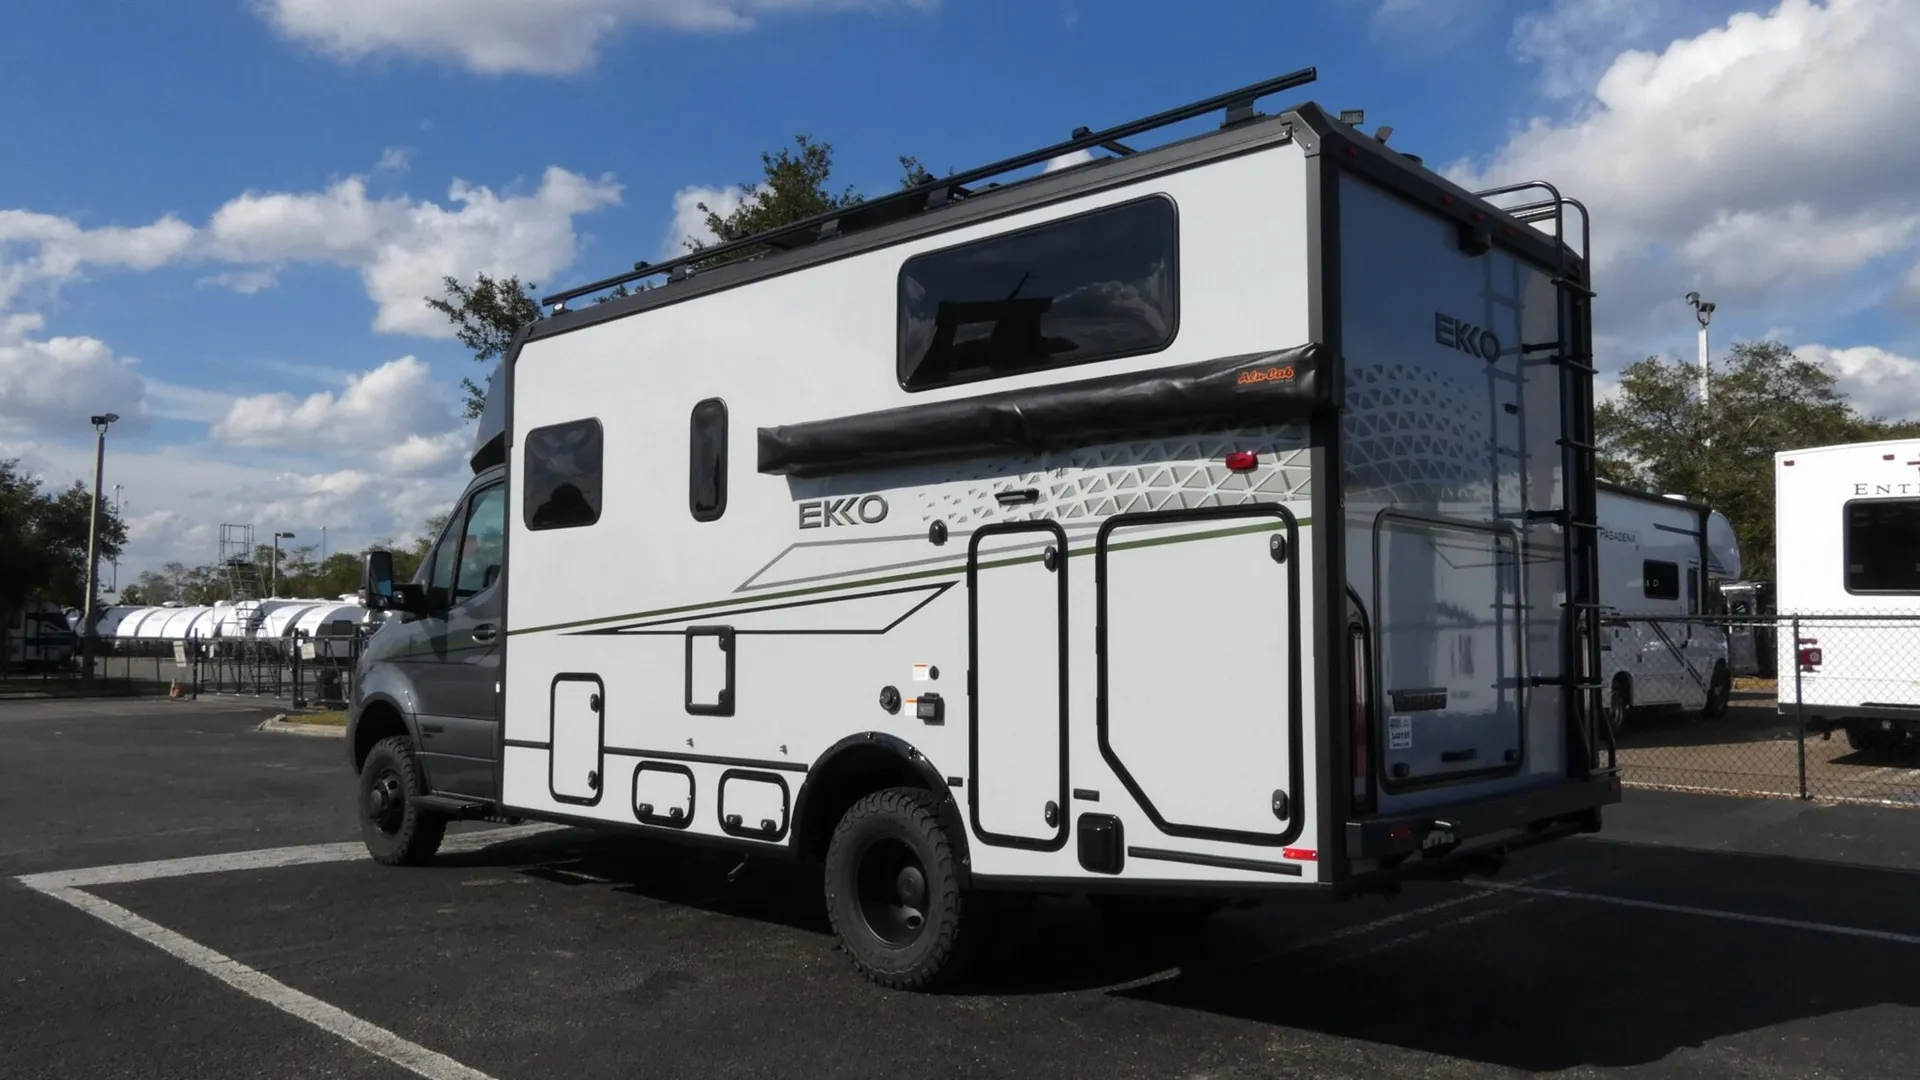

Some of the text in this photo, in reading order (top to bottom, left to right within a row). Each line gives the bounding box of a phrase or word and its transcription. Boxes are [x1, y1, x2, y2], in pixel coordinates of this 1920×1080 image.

[1435, 311, 1501, 363] EKKO
[1238, 365, 1294, 384] Alu-Cab
[1854, 483, 1920, 496] ENT
[799, 494, 889, 530] EKKO
[1599, 528, 1635, 543] PASADENA
